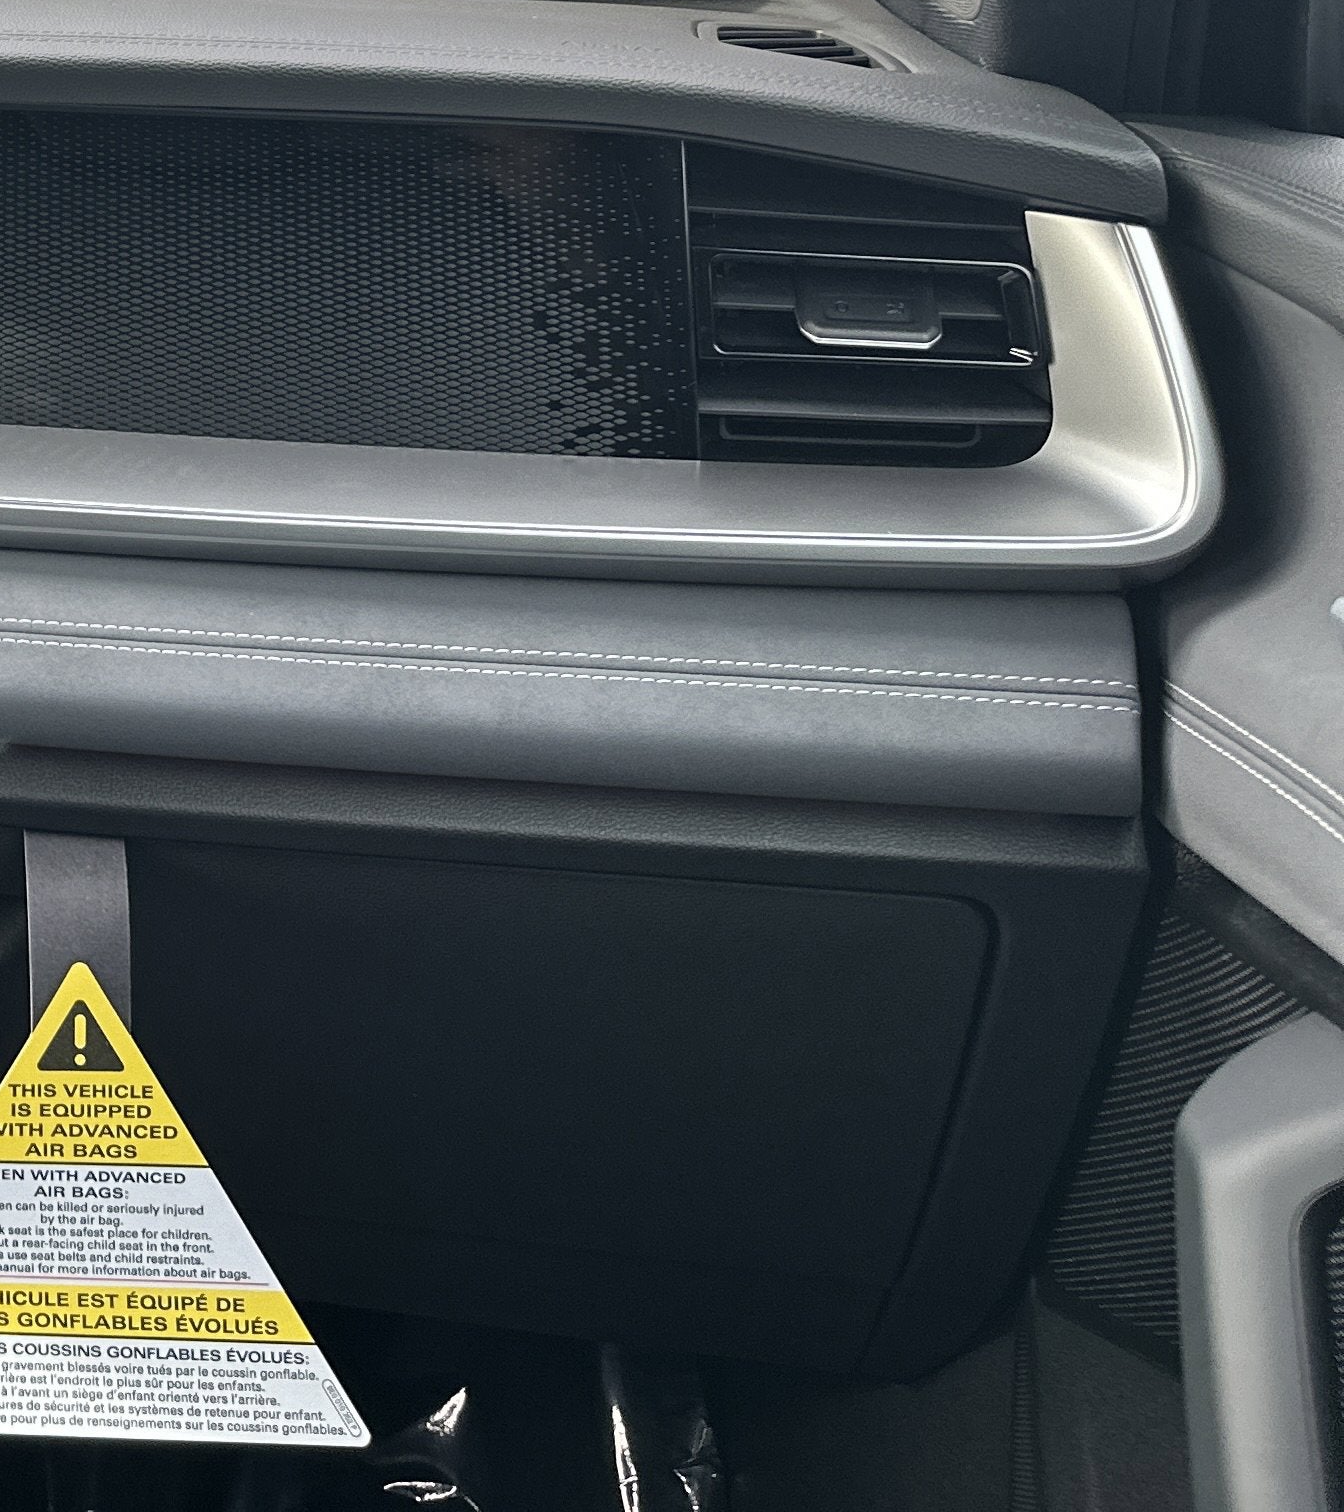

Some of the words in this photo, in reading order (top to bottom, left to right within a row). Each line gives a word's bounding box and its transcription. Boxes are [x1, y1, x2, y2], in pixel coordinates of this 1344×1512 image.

[7, 1084, 56, 1098] THIS
[63, 1084, 154, 1099] VEHICLE
[10, 1103, 31, 1117] IS
[39, 1104, 152, 1120] EQUIPPED
[50, 1123, 179, 1139] ADVANCED
[24, 1143, 64, 1158] AIR
[72, 1144, 138, 1159] BAGS
[30, 1170, 78, 1182] WITH
[83, 1171, 187, 1184] ADVANCED
[33, 1186, 65, 1198] AIR
[71, 1187, 129, 1199] BAGS:
[14, 1203, 36, 1212] can
[38, 1200, 54, 1212] be
[56, 1201, 88, 1213] killed
[90, 1204, 103, 1213] or
[106, 1202, 160, 1217] seriously
[162, 1203, 205, 1218] injured
[40, 1214, 55, 1227] by
[57, 1214, 77, 1225] the
[79, 1214, 94, 1225] air
[97, 1215, 124, 1228] bag.
[7, 1224, 32, 1236] seat
[34, 1225, 45, 1236] is
[47, 1225, 66, 1237] the
[69, 1226, 104, 1238] safest
[107, 1227, 138, 1242] place
[141, 1228, 158, 1239] for
[160, 1228, 213, 1241] children.
[21, 1237, 84, 1253] rear-facing
[86, 1239, 116, 1251] child
[118, 1240, 143, 1252] seat
[145, 1241, 157, 1252] in
[159, 1241, 179, 1253] the
[181, 1242, 215, 1254] front.
[6, 1252, 28, 1261] use
[30, 1250, 55, 1262] seat
[57, 1251, 86, 1263] belts
[89, 1252, 111, 1263] and
[114, 1252, 143, 1264] child
[145, 1253, 205, 1266] restraints.
[37, 1262, 54, 1274] for
[56, 1265, 88, 1275] more
[91, 1264, 160, 1277] information
[162, 1266, 197, 1278] about
[199, 1267, 216, 1278] air
[218, 1267, 251, 1282] bags.
[76, 1293, 118, 1309] EST
[125, 1290, 207, 1313] ÉQUIPÉ
[215, 1297, 246, 1313] DE
[16, 1312, 167, 1332] GONFLABLES
[175, 1313, 280, 1336] ÉVOLUÉS
[11, 1343, 101, 1358] COUSSINS
[105, 1346, 221, 1362] GONFLABLES
[225, 1347, 310, 1365] ÉVOLUÉS:
